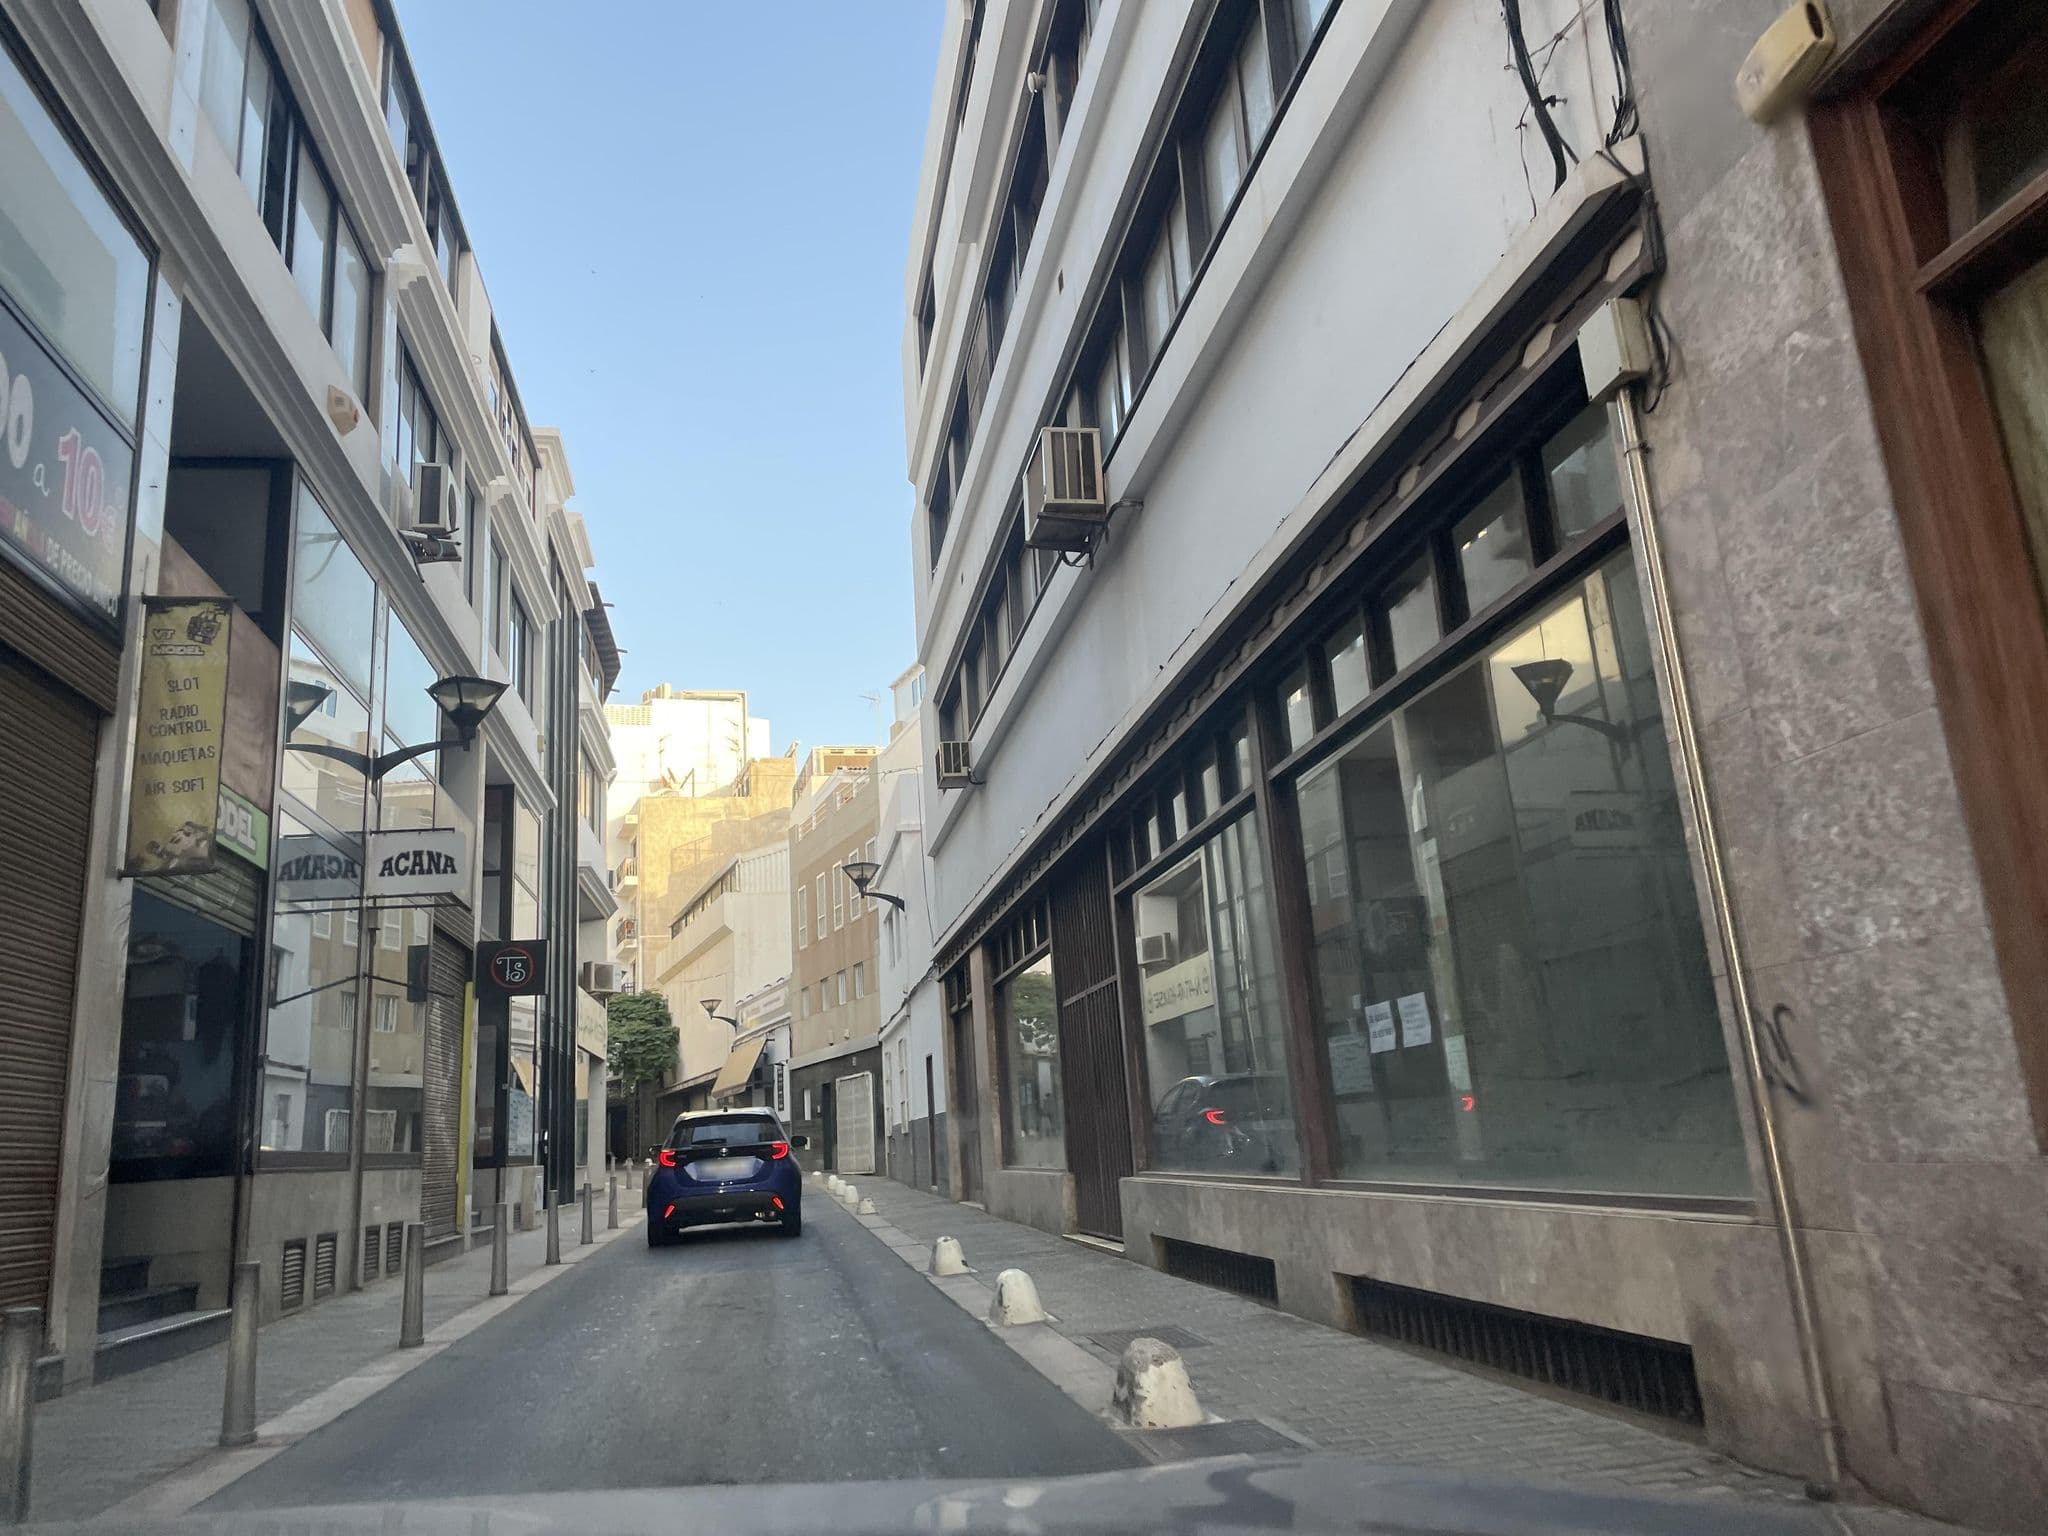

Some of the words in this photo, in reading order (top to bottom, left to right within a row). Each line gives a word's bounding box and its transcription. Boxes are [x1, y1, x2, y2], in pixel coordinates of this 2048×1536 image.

[167, 677, 200, 693] SLOT
[160, 704, 199, 720] RADIO
[149, 719, 212, 736] CONTROL
[140, 745, 216, 767] MAQUETAS
[144, 781, 166, 795] AIR
[172, 777, 205, 793] SOFT
[378, 850, 458, 877] ACANA
